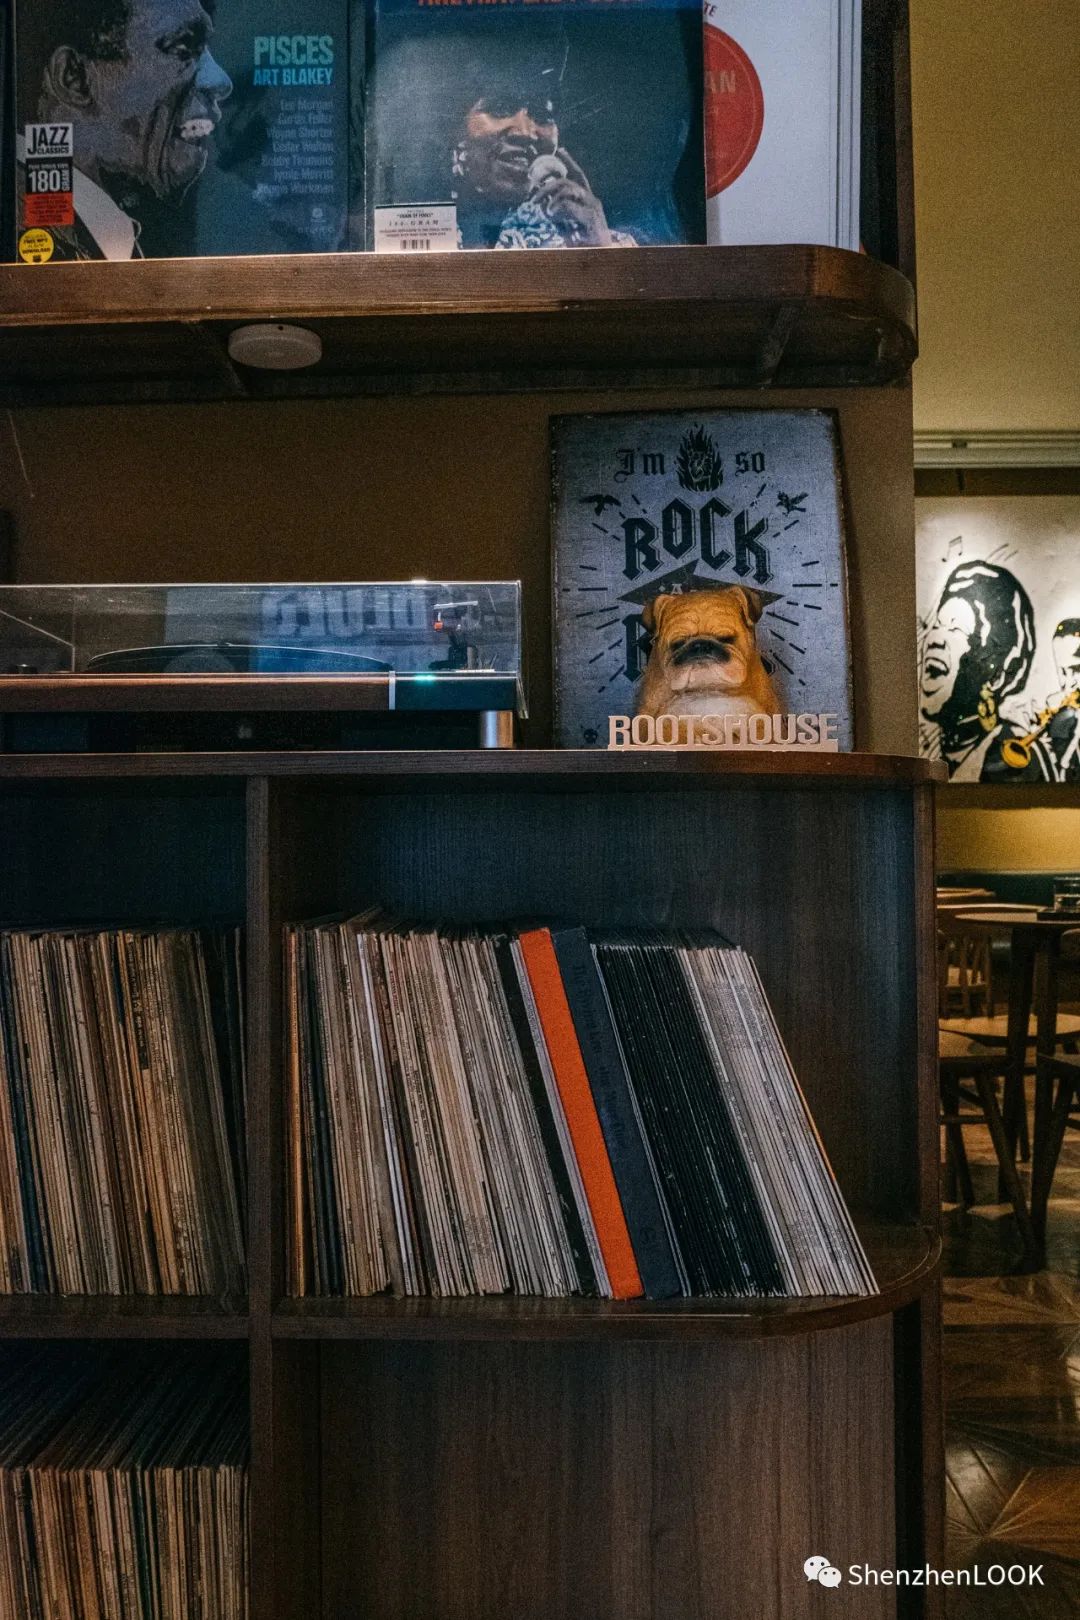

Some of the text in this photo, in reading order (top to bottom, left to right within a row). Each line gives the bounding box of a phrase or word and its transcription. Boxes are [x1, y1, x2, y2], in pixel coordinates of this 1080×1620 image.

[254, 35, 334, 66] PISCES
[253, 67, 333, 86] ART BLAKEY
[27, 126, 70, 155] JAZZ
[36, 146, 70, 154] CLASSICS
[28, 170, 60, 192] 180
[735, 451, 766, 477] so
[621, 497, 774, 585] ROCK
[608, 714, 839, 747] ROOTSHOUSE
